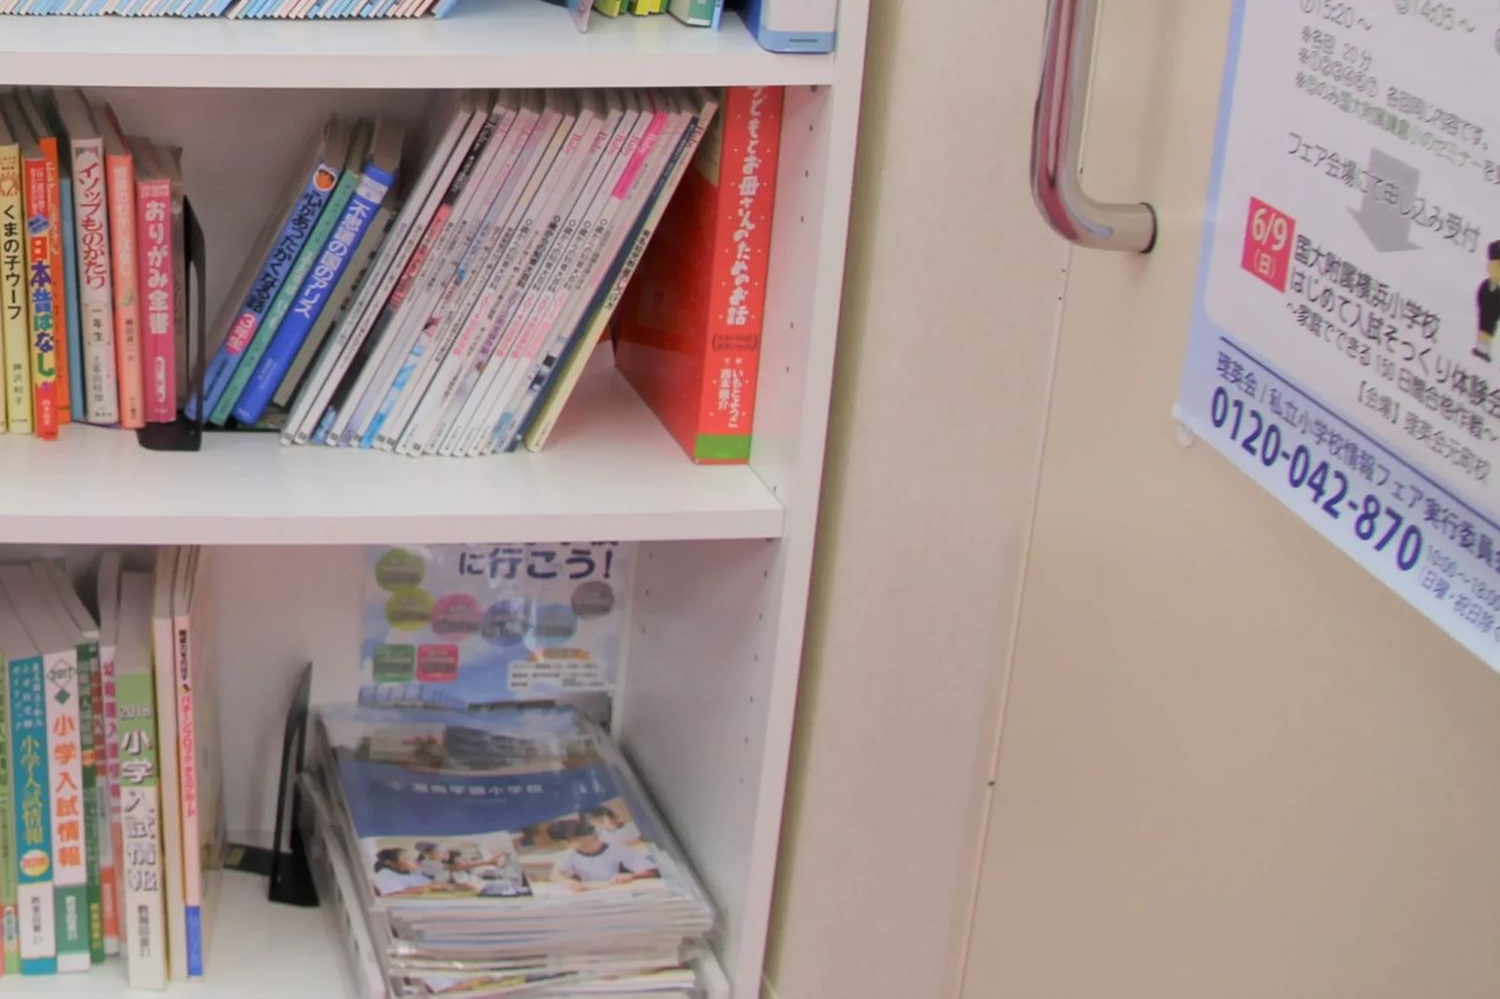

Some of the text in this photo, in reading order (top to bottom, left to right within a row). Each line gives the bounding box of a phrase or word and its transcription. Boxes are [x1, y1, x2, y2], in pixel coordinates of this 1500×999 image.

[2, 203, 23, 321] くまの子ウーフ
[79, 162, 106, 290] イソップものがたり
[144, 200, 170, 336] おりがみ全書
[246, 190, 322, 315] 心があったかくなる話
[294, 200, 371, 319] 不思議の国のアリス
[1250, 206, 1288, 253] 6/9
[1210, 384, 1423, 572] 0120-042-870
[457, 549, 615, 580] に行こう!
[20, 734, 44, 846] 小学入試情報
[52, 713, 83, 867] 小学入試情報
[120, 727, 160, 893] 小学入試情報
